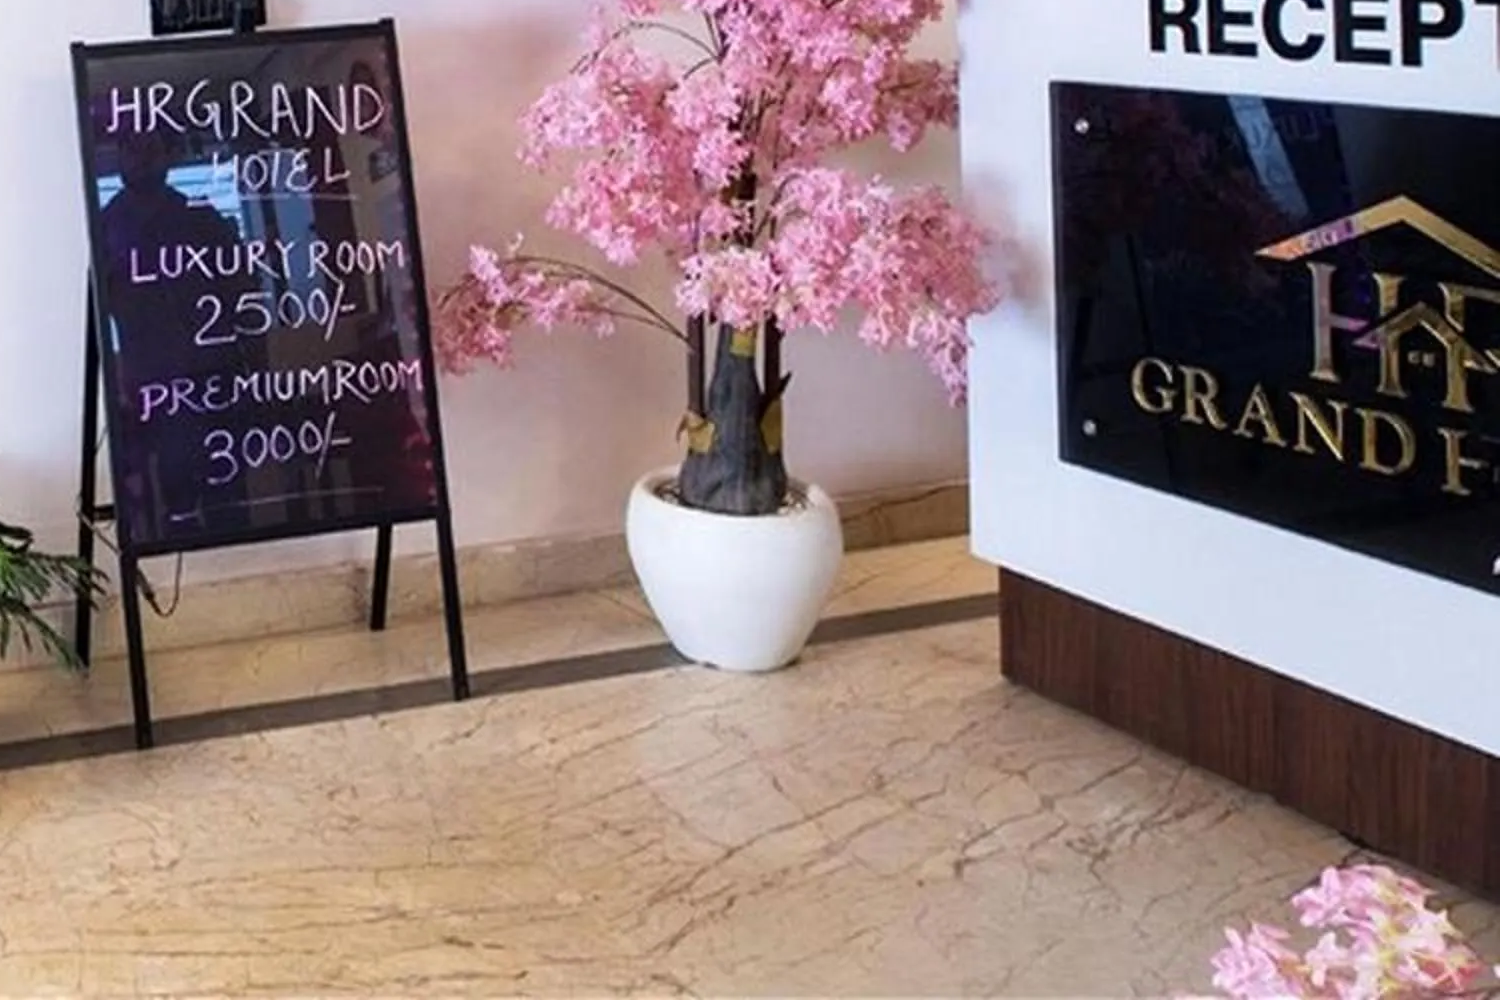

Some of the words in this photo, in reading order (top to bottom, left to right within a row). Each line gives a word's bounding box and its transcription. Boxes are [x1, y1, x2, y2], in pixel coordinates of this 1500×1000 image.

[211, 147, 352, 192] HOTEL
[130, 238, 293, 284] LUXURY
[307, 240, 405, 280] ROOM
[1130, 355, 1417, 477] GRAND
